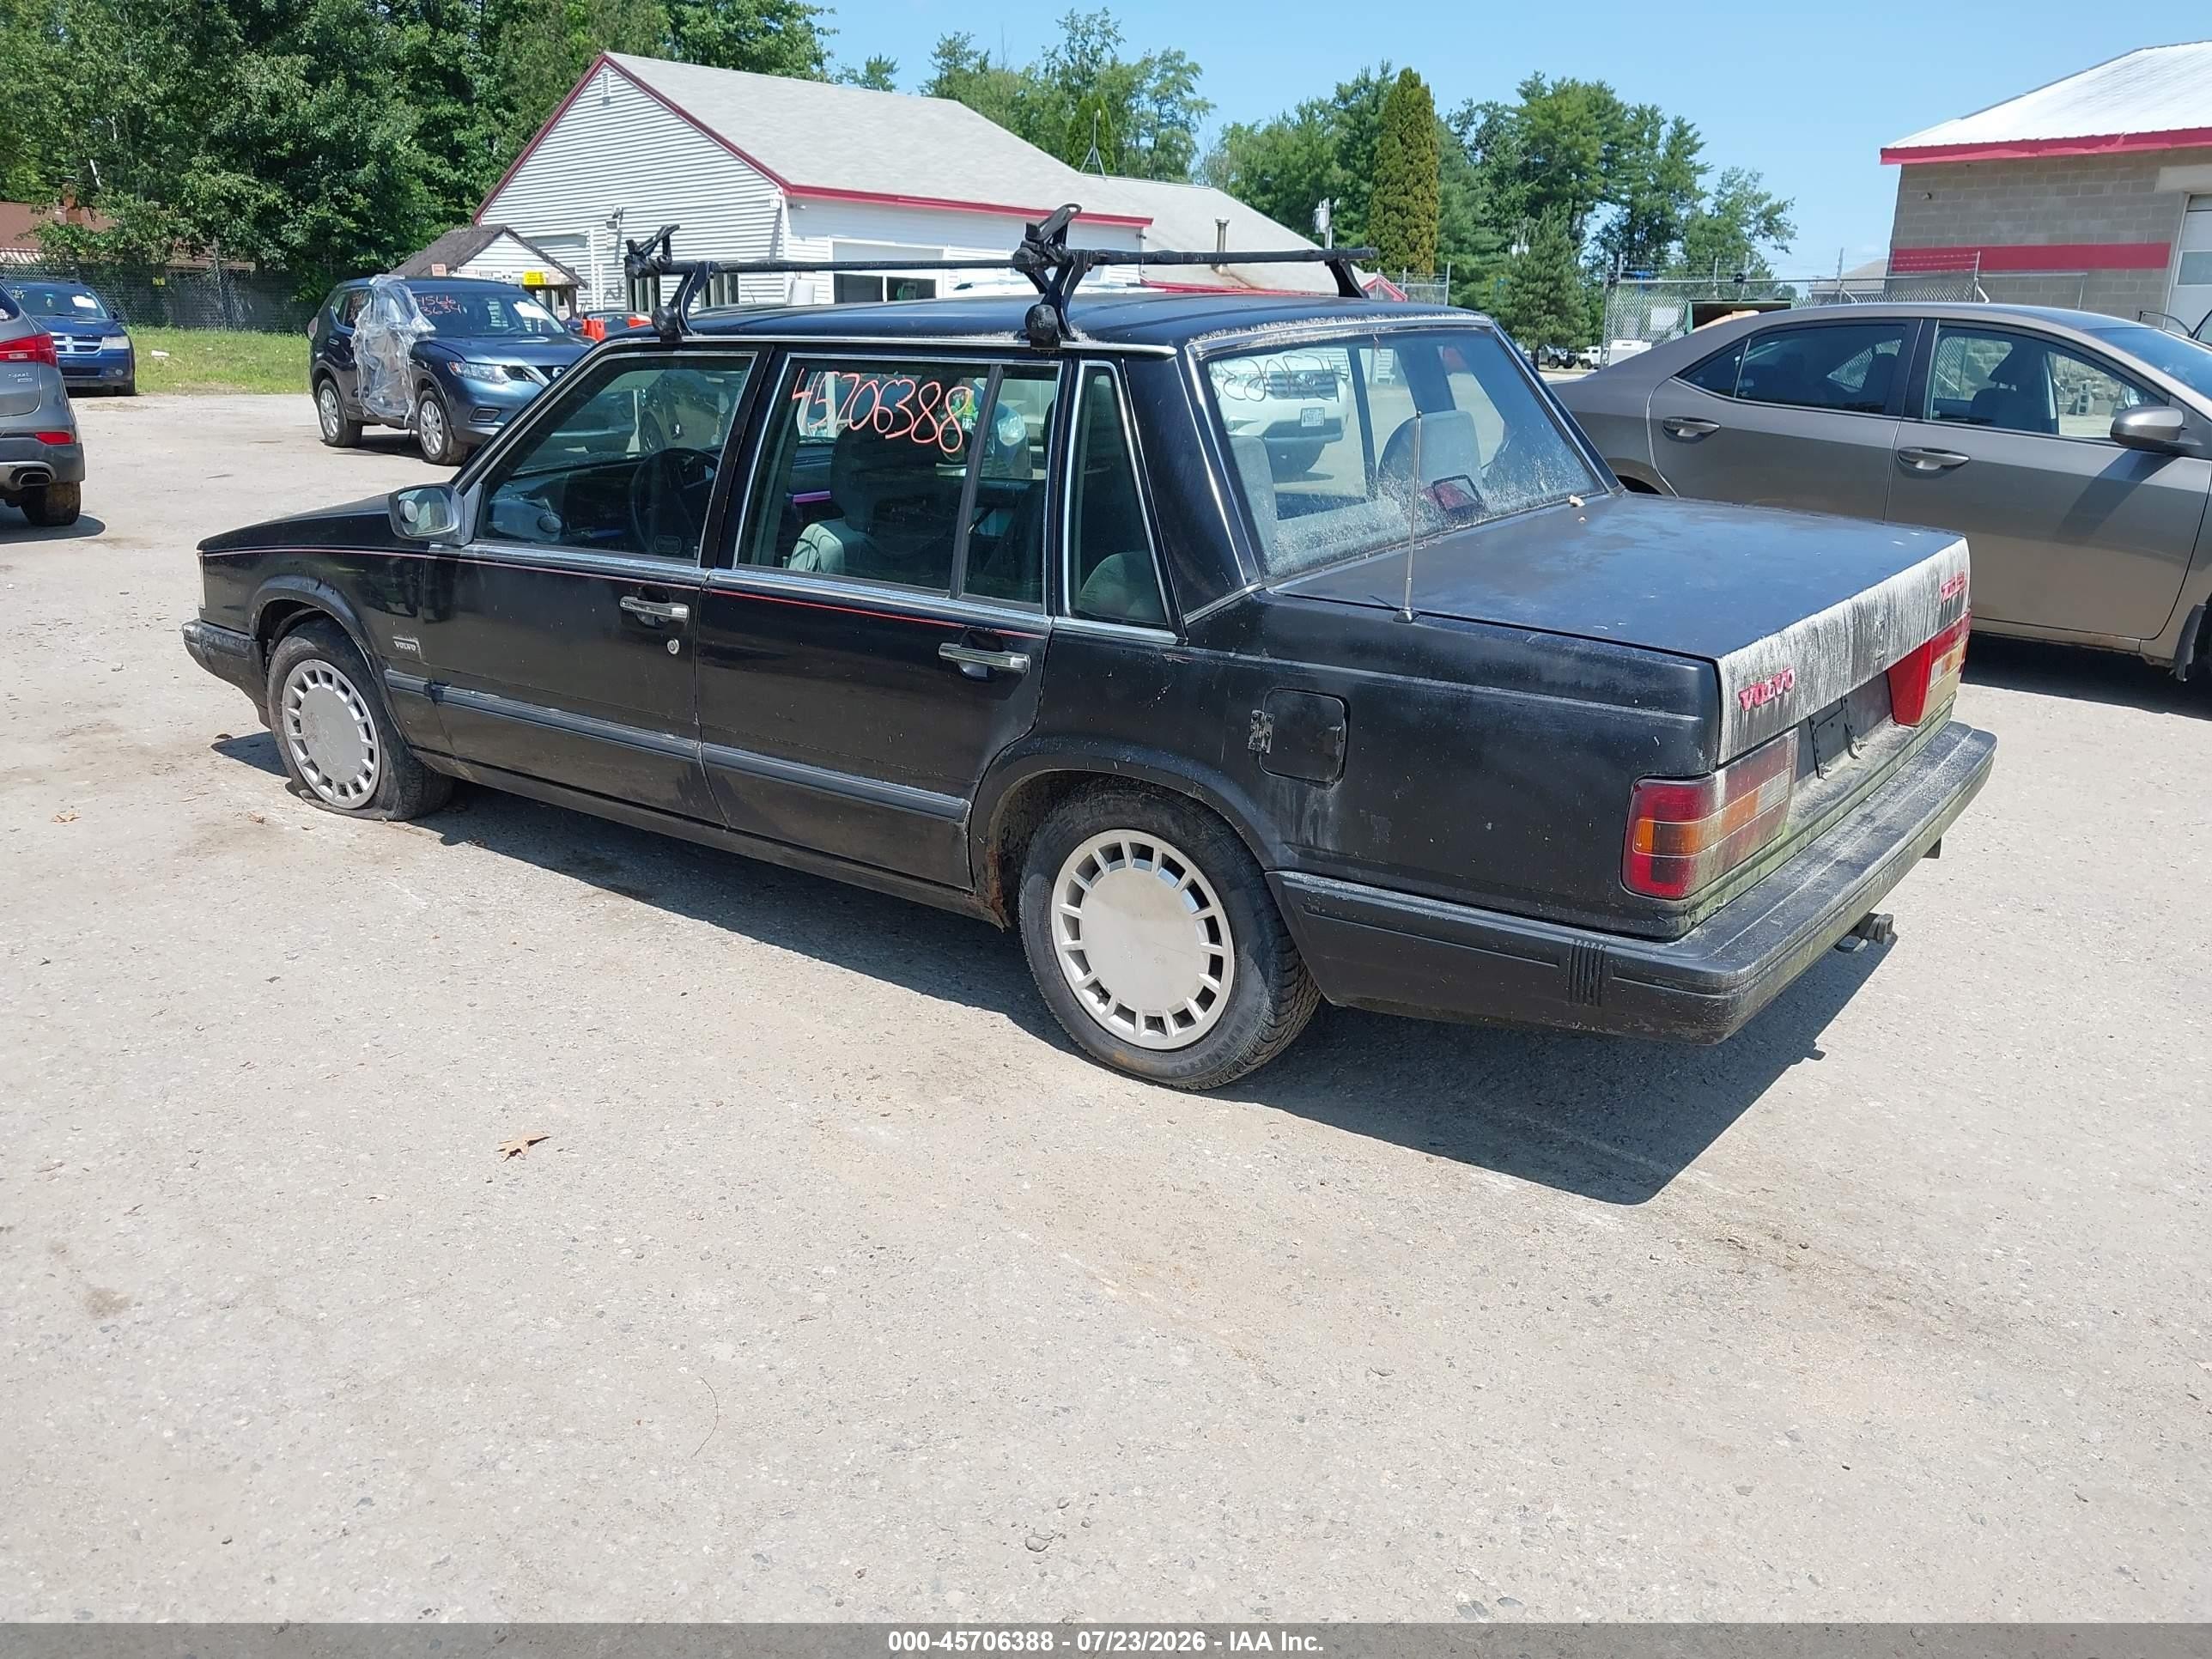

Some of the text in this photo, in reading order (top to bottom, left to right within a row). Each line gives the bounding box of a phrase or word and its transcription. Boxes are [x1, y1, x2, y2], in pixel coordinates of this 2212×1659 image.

[792, 367, 971, 453] 45706388
[393, 640, 416, 652] VOLVO
[1738, 667, 1796, 712] VOLVO
